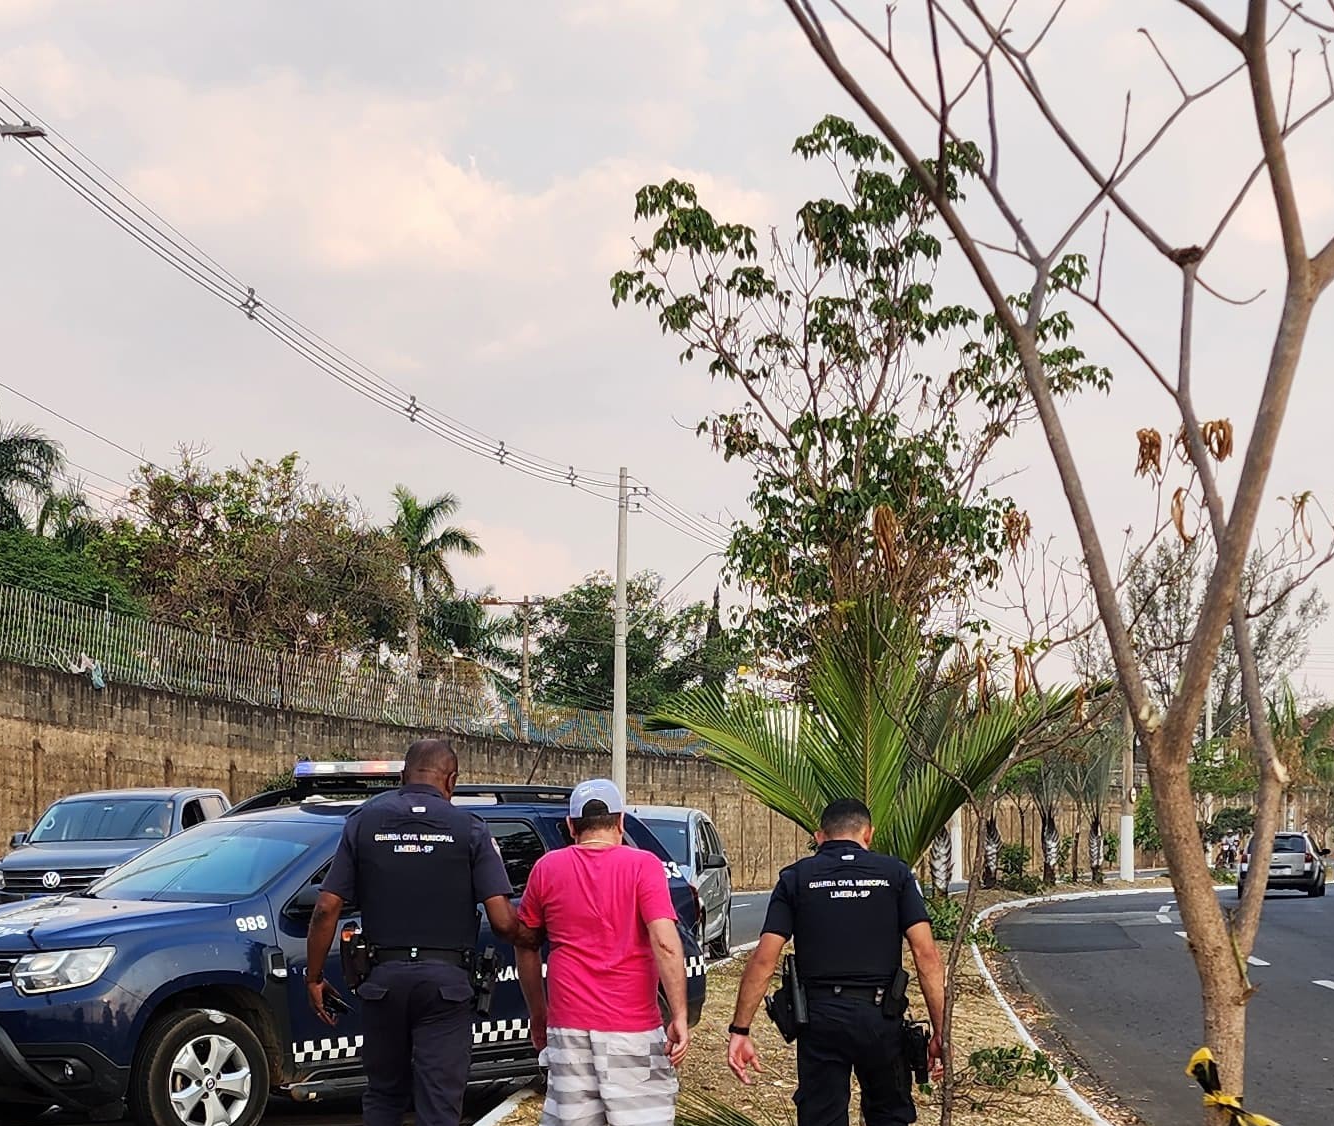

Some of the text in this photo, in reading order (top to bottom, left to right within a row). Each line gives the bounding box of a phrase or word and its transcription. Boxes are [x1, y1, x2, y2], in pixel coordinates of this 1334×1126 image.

[402, 833, 419, 841] CIVIL
[420, 834, 454, 842] MUNICIPAL
[394, 845, 434, 853] LIMEIRA-SP
[830, 890, 870, 898] LIMEIRA-SP
[235, 914, 268, 932] 988
